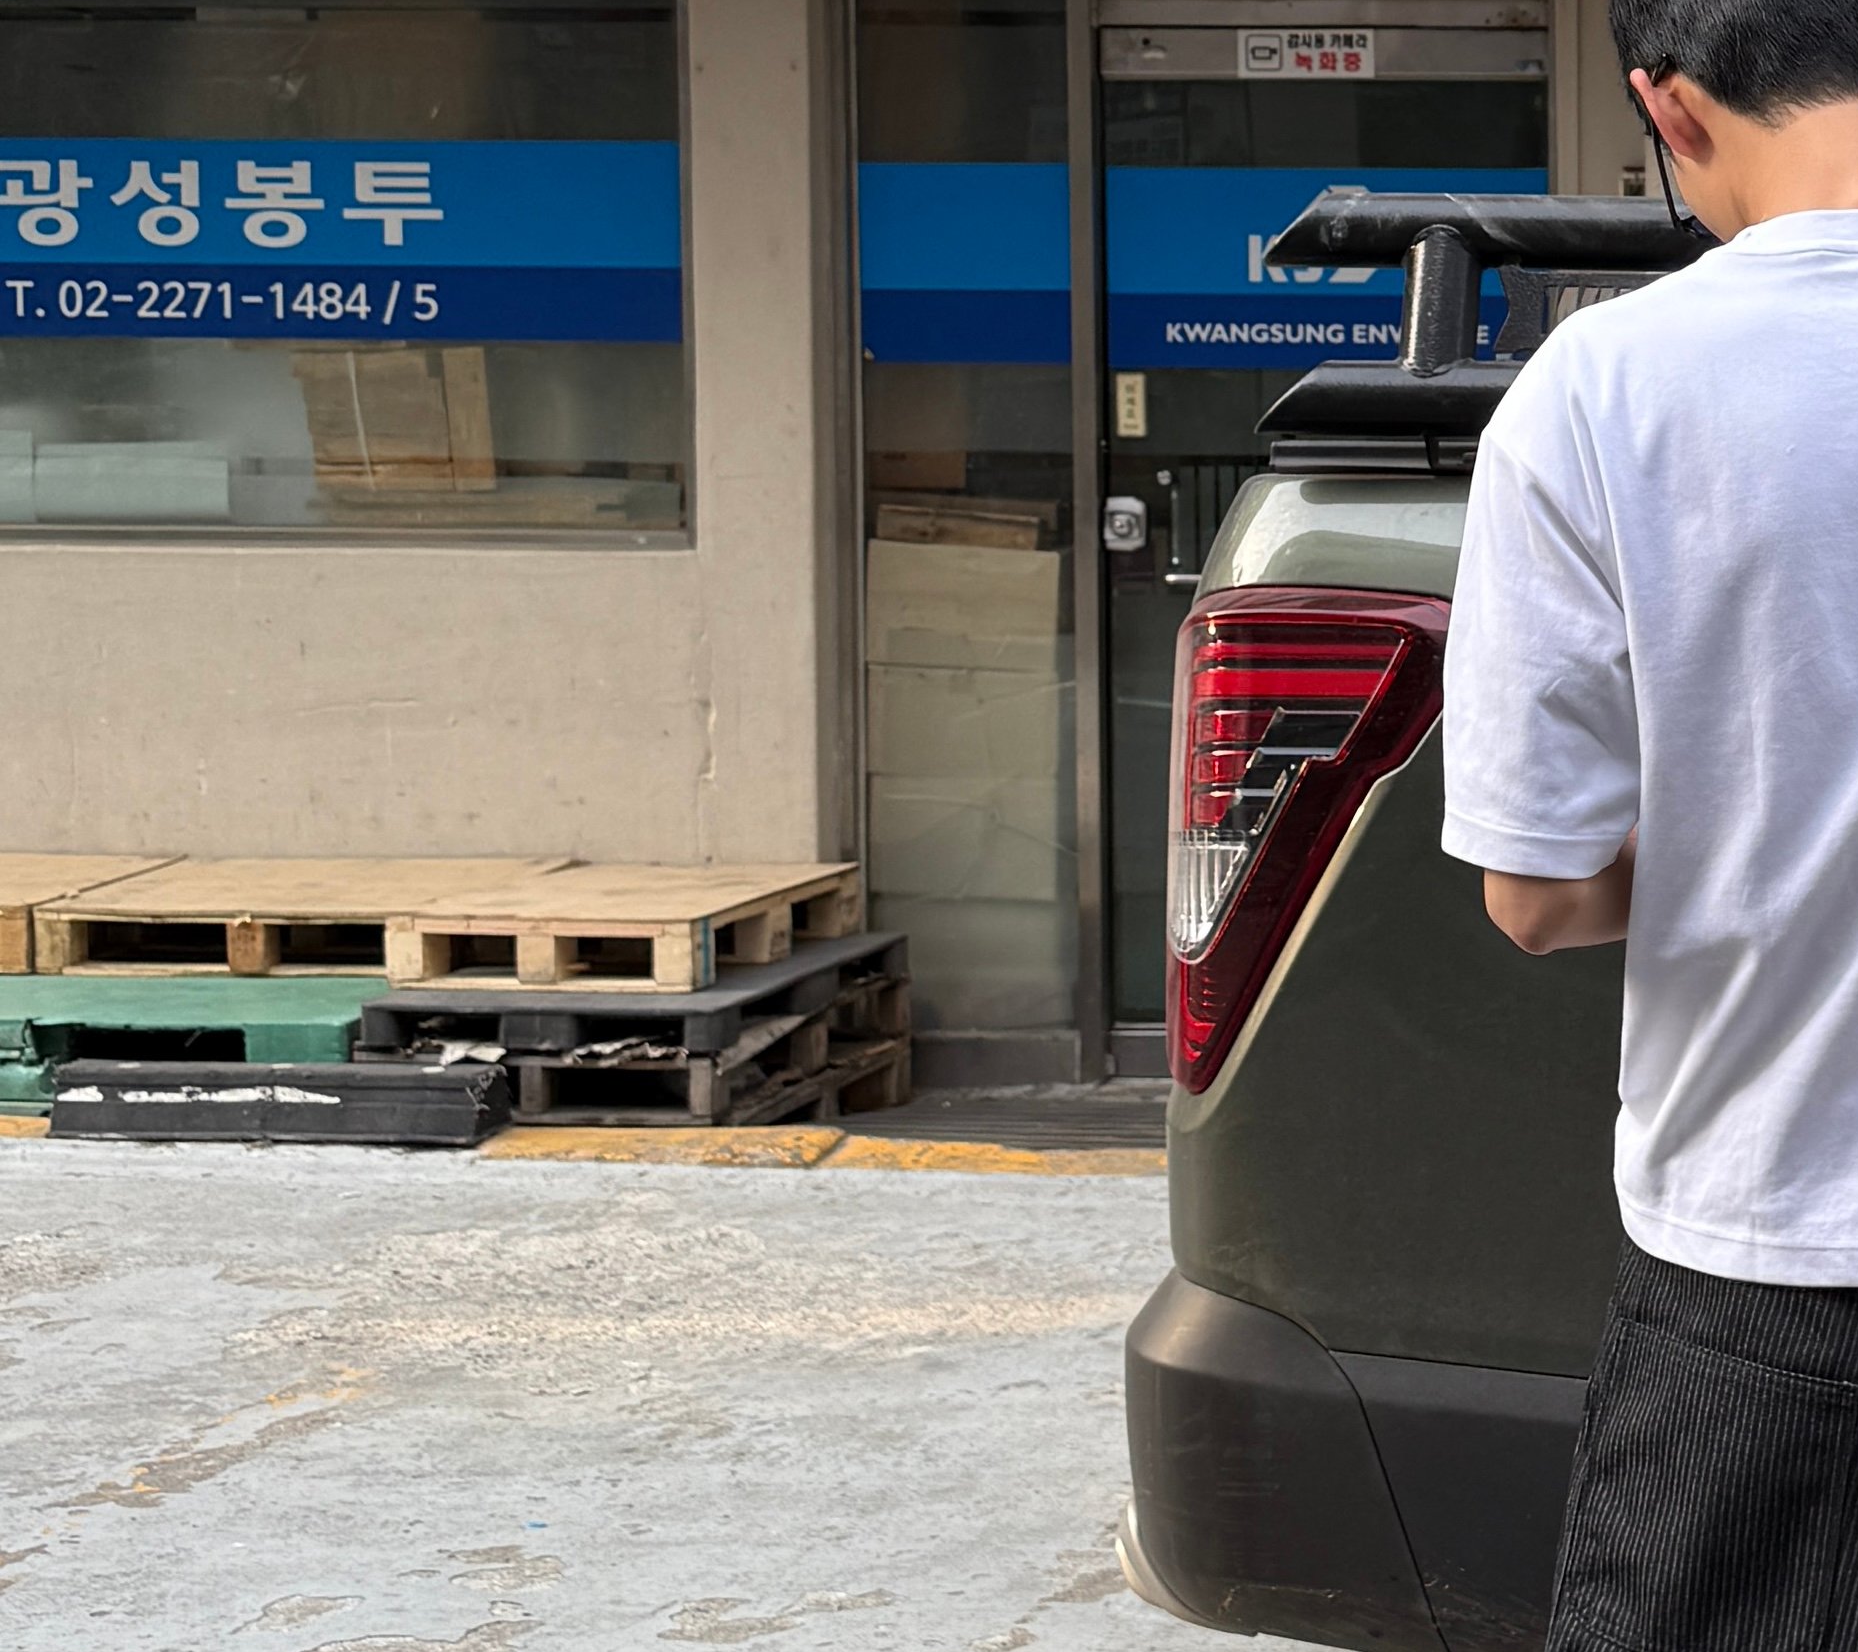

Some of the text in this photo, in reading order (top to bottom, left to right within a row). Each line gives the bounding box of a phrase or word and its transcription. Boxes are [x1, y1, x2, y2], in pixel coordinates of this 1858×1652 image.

[0, 160, 444, 248] 광성봉투
[5, 280, 46, 318] T.
[59, 280, 371, 320] 02-2271-1484
[414, 283, 438, 320] 5
[1166, 323, 1345, 344] KWANGSUNG
